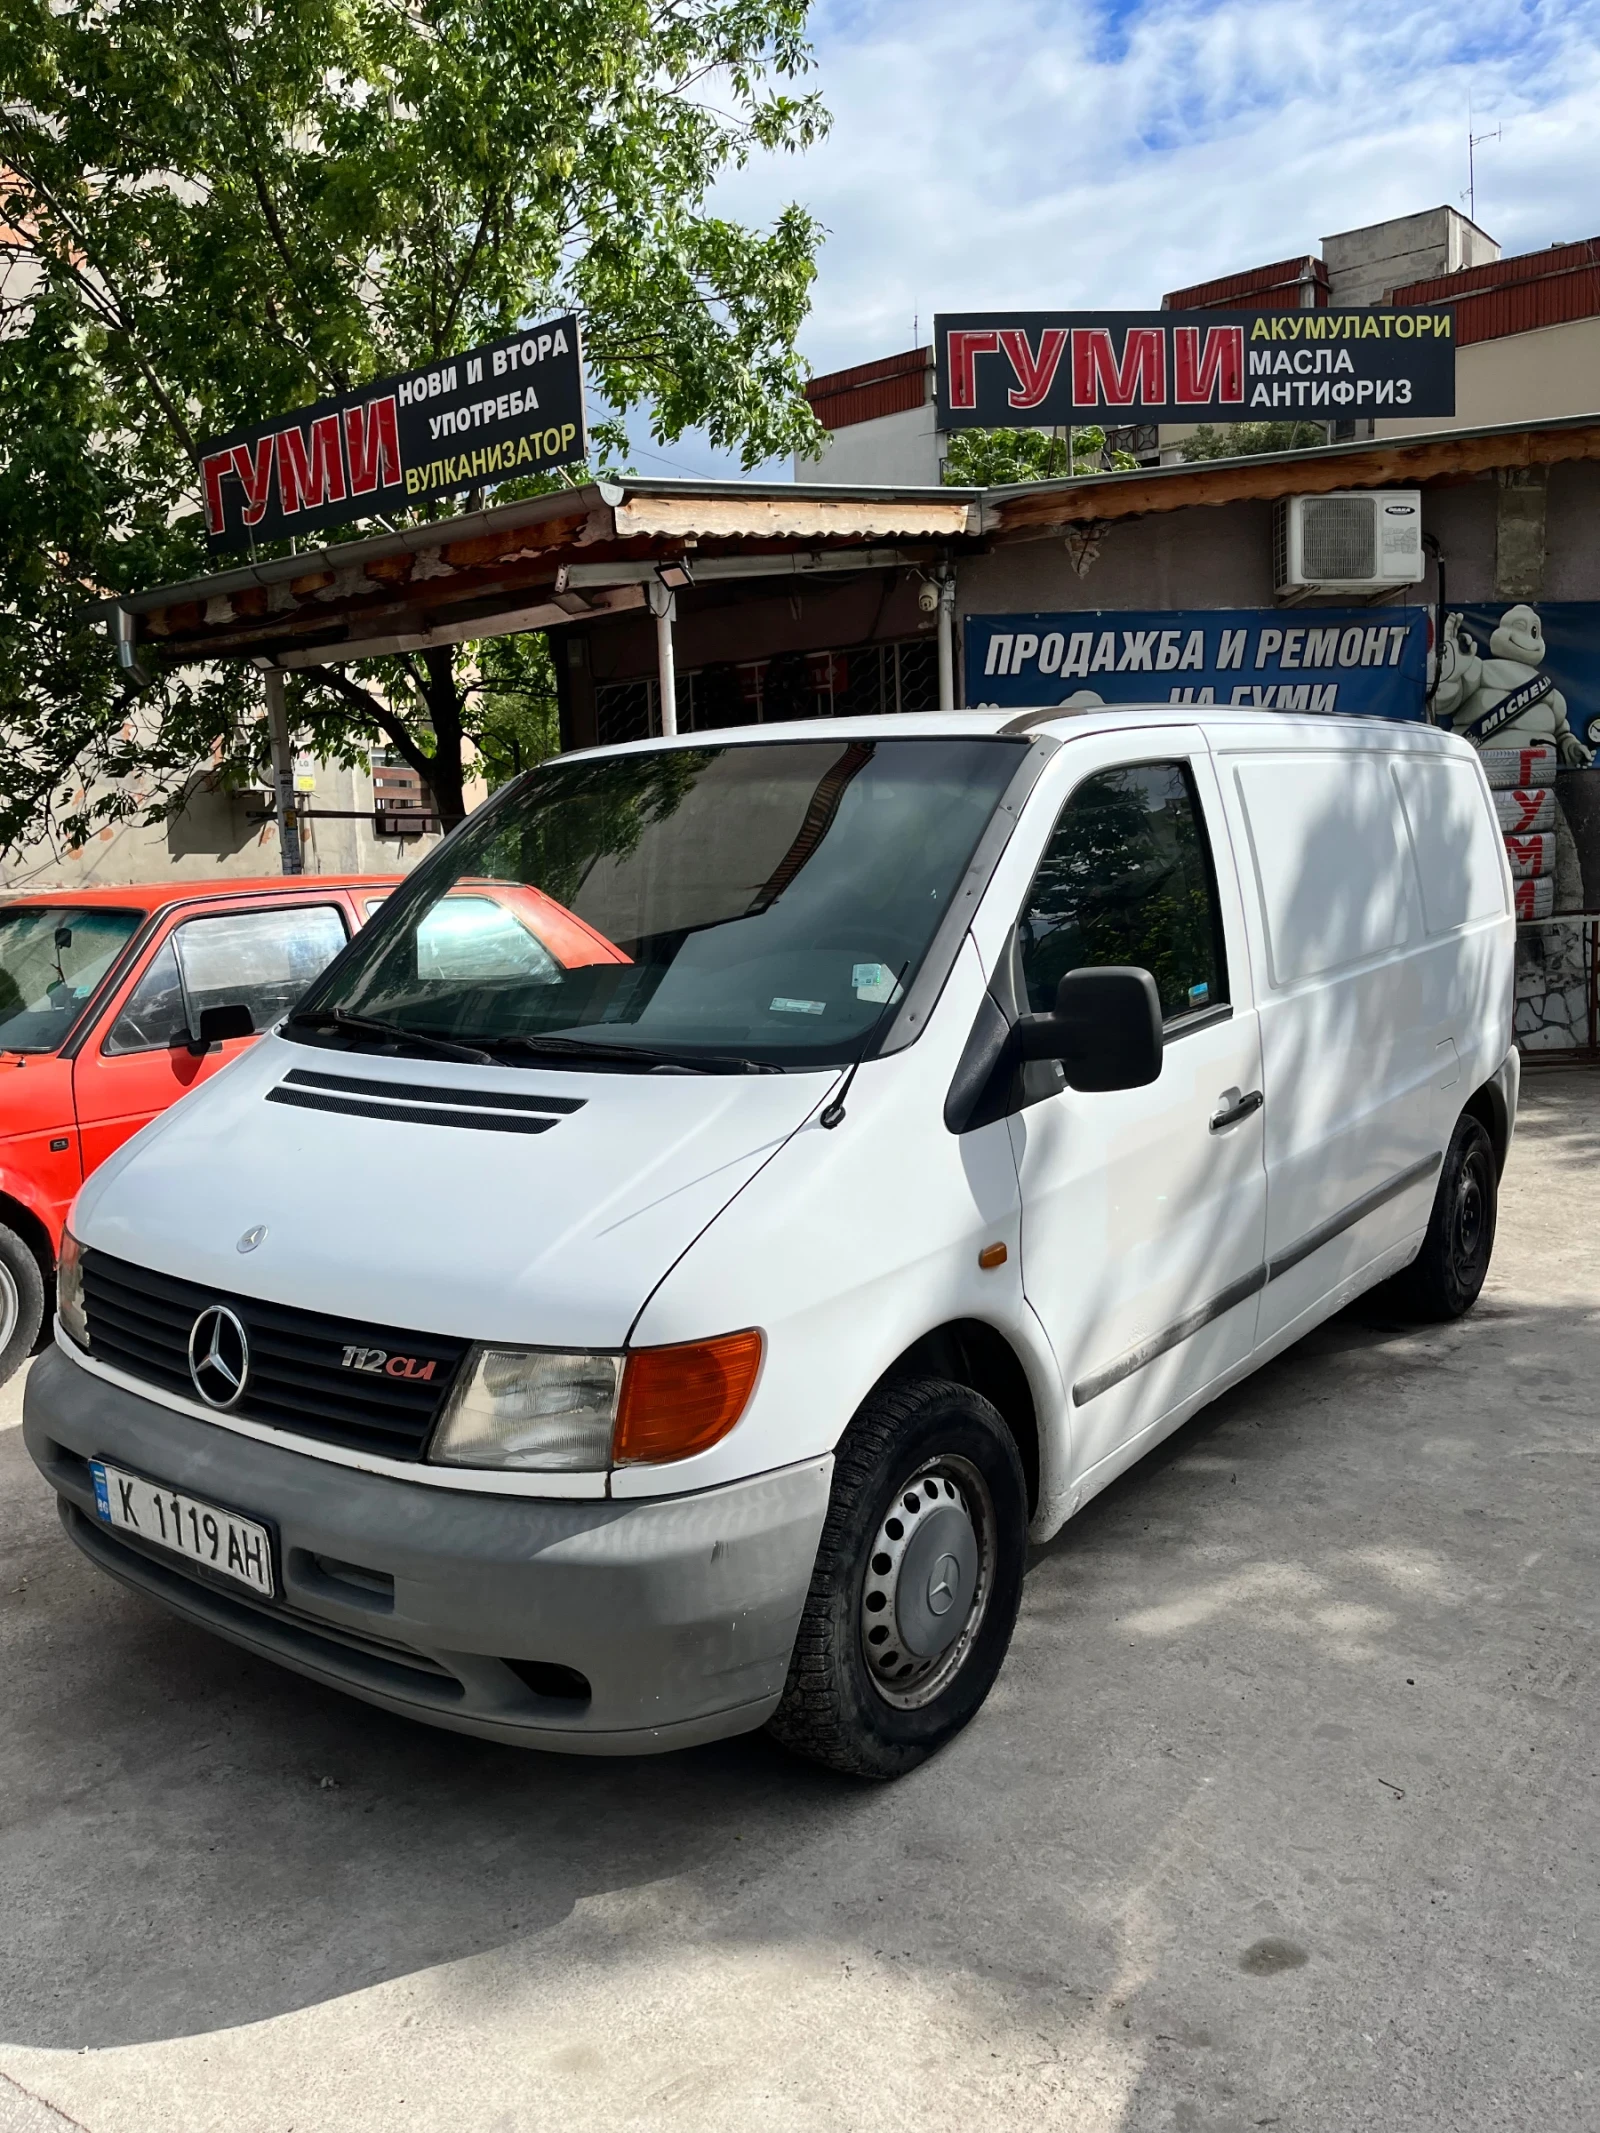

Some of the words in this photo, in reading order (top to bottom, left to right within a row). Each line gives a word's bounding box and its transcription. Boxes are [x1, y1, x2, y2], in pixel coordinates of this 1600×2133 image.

[1250, 314, 1452, 341] АКУМУЛАТОРИ
[399, 365, 458, 407] НОВИ
[467, 357, 483, 385] И
[493, 328, 569, 377] ВТОРА
[947, 325, 1245, 410] ГУМИ
[1249, 348, 1355, 376] МАСЛА
[428, 386, 540, 440] УПОТРЕБА
[1249, 379, 1413, 408] АНТИФРИЗ
[200, 394, 403, 536] ГУМИ
[404, 422, 577, 496] ВУЛКАНИЗАТОР
[984, 630, 1201, 678] ПРОДАЖБА
[1215, 629, 1247, 669] И
[1254, 626, 1411, 669] РЕМОНТ
